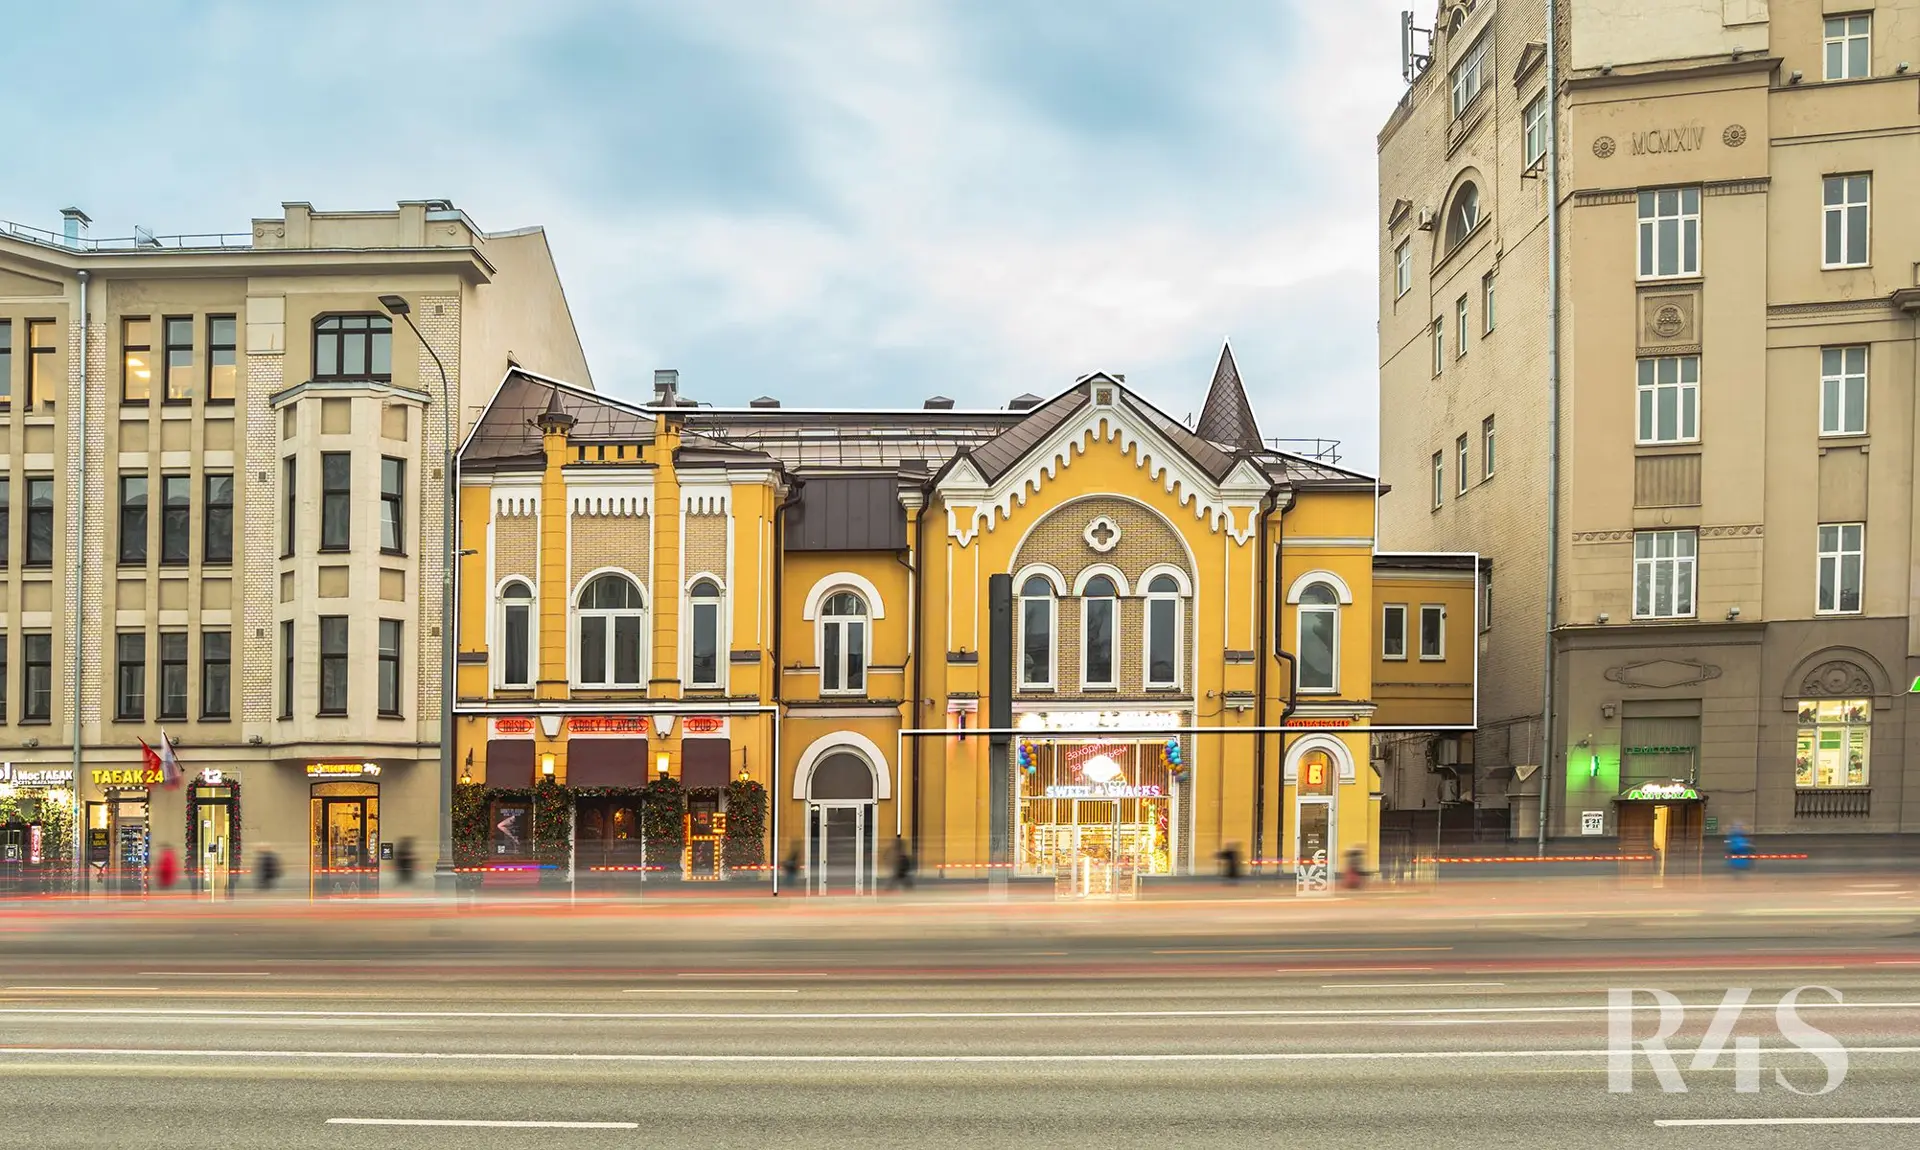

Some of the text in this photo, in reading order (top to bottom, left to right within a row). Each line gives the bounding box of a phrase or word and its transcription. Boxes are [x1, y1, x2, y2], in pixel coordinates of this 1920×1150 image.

[1632, 126, 1705, 156] MCMXIV
[502, 719, 525, 732] IRISH
[572, 718, 644, 731] ABBEY PLAYERS
[694, 718, 711, 731] PUB
[91, 769, 164, 784] ТАБАК 24
[202, 768, 223, 783] t2
